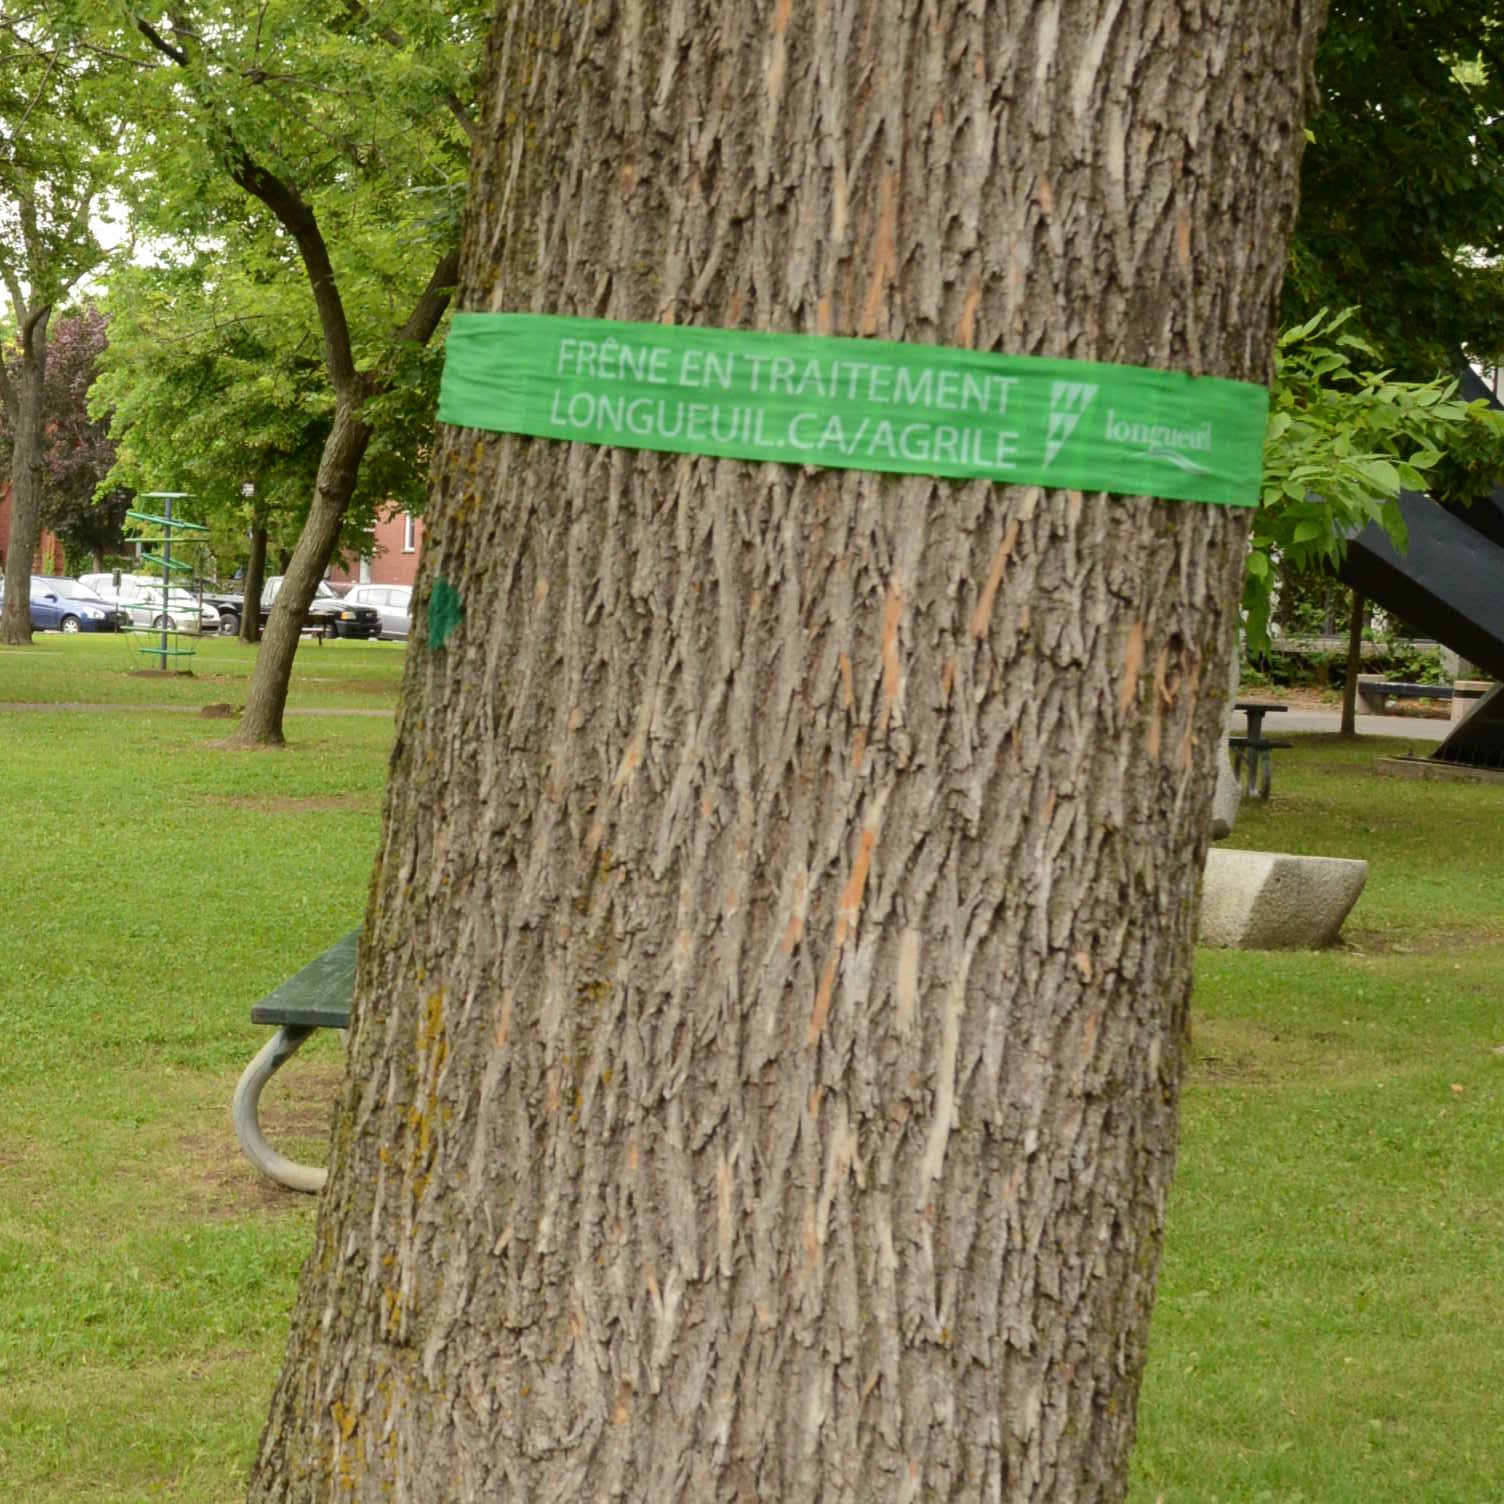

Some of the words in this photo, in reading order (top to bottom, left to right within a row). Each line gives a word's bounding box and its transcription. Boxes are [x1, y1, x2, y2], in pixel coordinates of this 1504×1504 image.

[557, 338, 671, 384] FRÊNE
[679, 349, 735, 389] EN
[744, 353, 1020, 414] TRAITEMENT
[549, 387, 1019, 470] LONGUEUIL.CA/AGRILE
